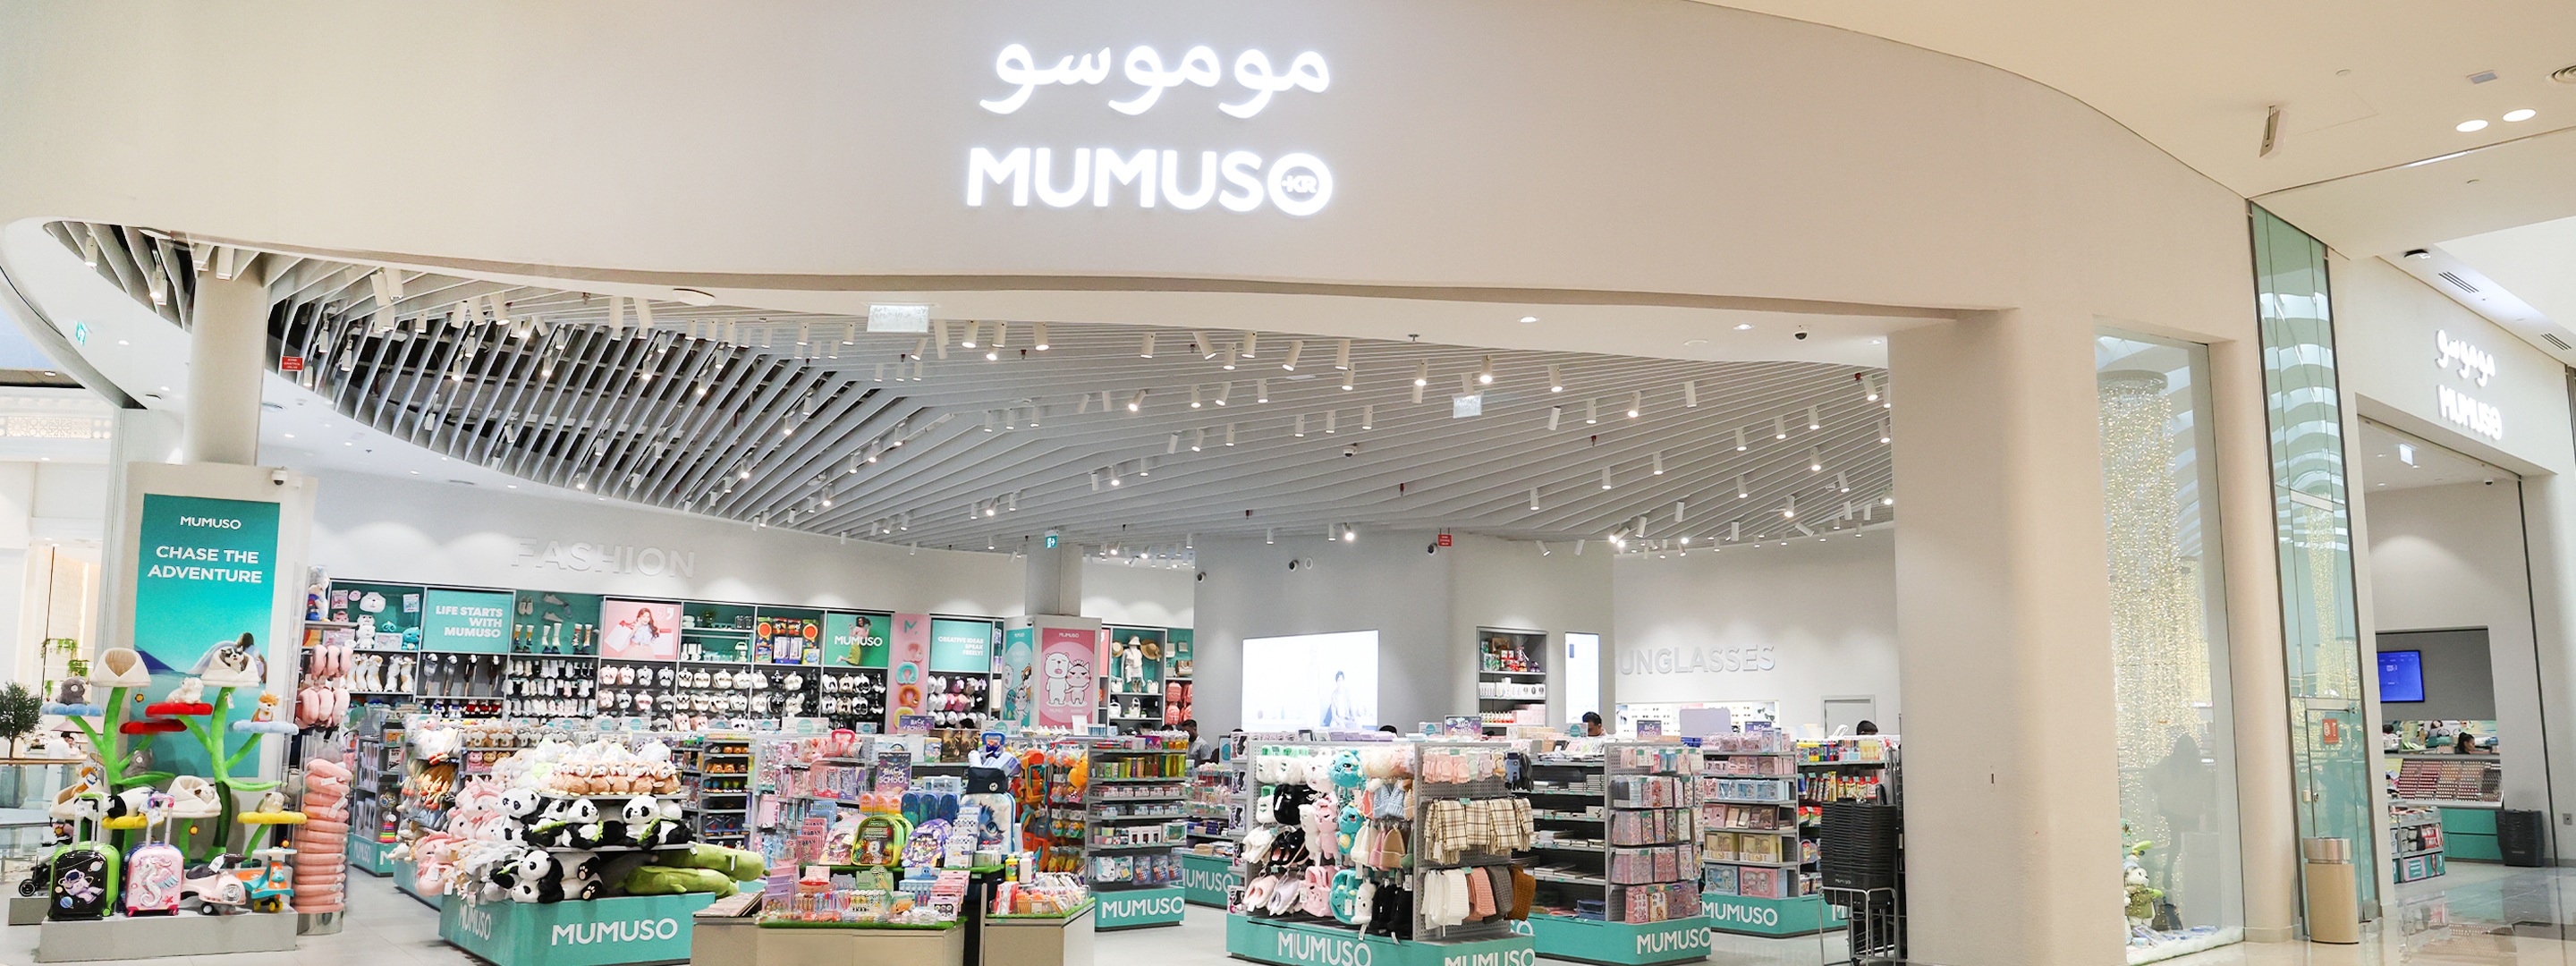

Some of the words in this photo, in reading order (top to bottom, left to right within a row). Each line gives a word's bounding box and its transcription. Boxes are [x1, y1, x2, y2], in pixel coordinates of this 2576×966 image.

[967, 147, 1333, 216] MUMUSO
[2437, 384, 2503, 441] MUMUSO
[180, 516, 242, 530] MUMUSO
[156, 546, 219, 562] CHASE
[224, 549, 259, 564] THE
[512, 538, 696, 579] FASHION
[148, 564, 263, 583] ADVENTURE
[436, 605, 458, 616] LIFE
[460, 606, 504, 617] STARTS
[469, 617, 503, 628] WITH
[444, 627, 501, 638] MUMUSO
[834, 635, 883, 647] MUMUSO
[1617, 644, 1775, 676] UNGLASSES
[878, 775, 909, 784] SCHOOL
[883, 767, 904, 775] BACK
[1101, 896, 1185, 919] MUMUSO
[1701, 901, 1778, 927] MUMUSO
[458, 903, 491, 941] MUMUSO
[551, 918, 678, 946] MUMUSO
[1277, 931, 1372, 966] MUMUSO
[1636, 926, 1711, 955] MUMUSO
